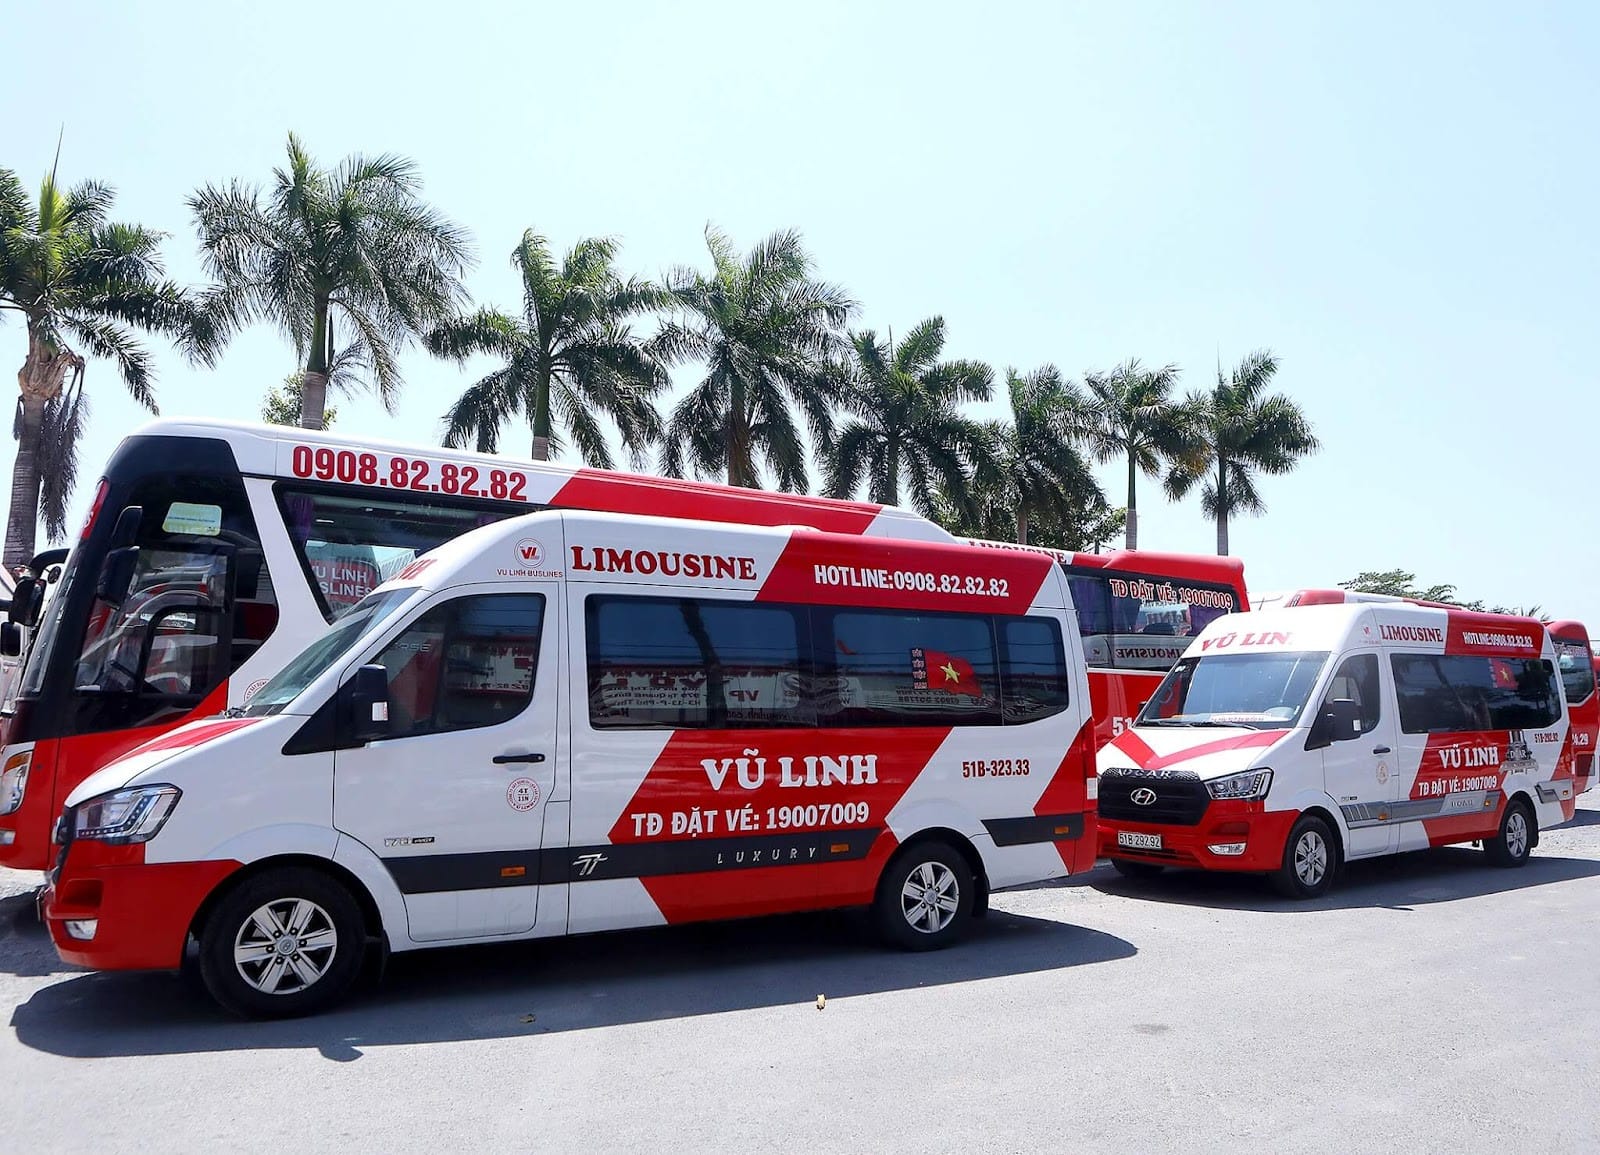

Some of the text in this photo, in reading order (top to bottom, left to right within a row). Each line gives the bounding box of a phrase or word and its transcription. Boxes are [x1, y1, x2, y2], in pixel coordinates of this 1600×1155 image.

[292, 445, 527, 501] 0908.82.82.82
[497, 568, 563, 578] VU LINH BUSLINES
[570, 545, 757, 580] LIMOUSINE
[332, 567, 367, 583] LINH
[814, 564, 1010, 598] HOTLINE:0908.82.82.82
[1109, 578, 1233, 609] TĐ ĐẶT VÉ: 19007009
[1202, 632, 1237, 651] VŨ
[1379, 624, 1444, 643] LIMOUSINE
[1438, 744, 1461, 769] VŨ
[1465, 746, 1499, 767] LINH
[700, 748, 879, 791] VŨ LINH
[962, 759, 1030, 778] 51B-323.33
[1418, 775, 1497, 797] TĐ ĐẶT VÉ: 19007009
[631, 801, 870, 838] TĐ ĐẶT VÉ: 19007009
[717, 847, 816, 864] LUXURY
